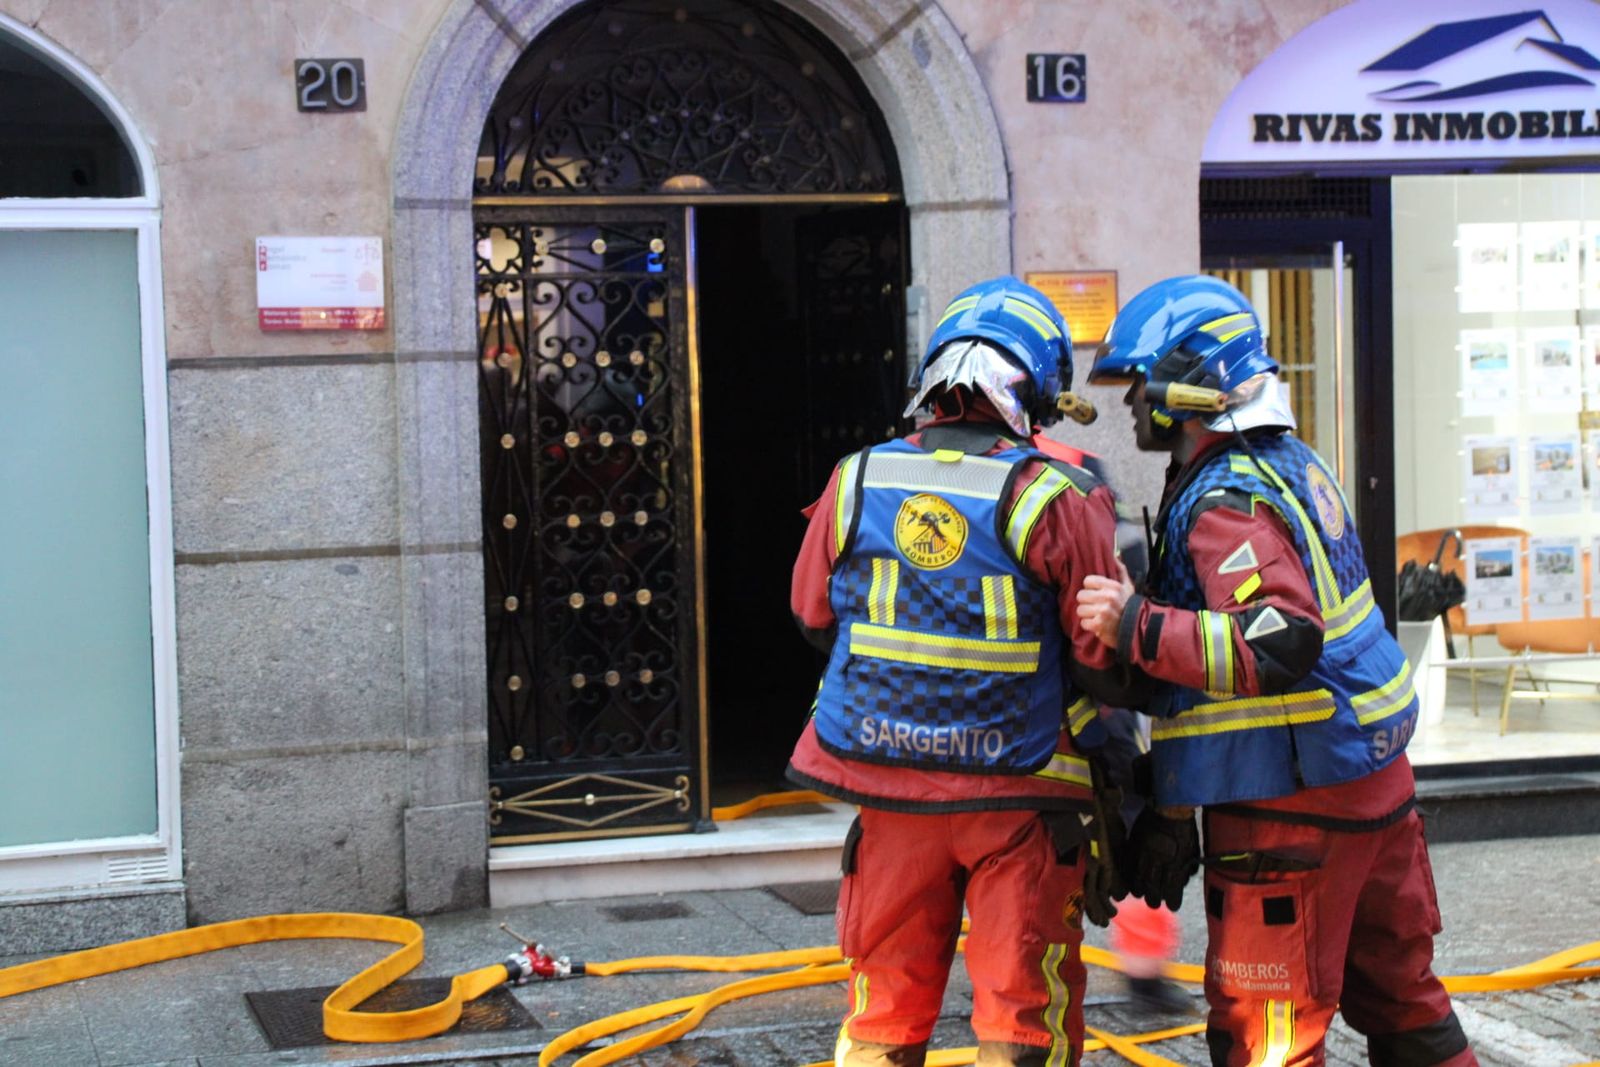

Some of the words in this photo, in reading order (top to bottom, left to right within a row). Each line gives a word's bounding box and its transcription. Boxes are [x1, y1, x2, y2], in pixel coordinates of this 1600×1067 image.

[299, 61, 357, 106] 20
[1034, 55, 1080, 98] 16
[1253, 113, 1382, 142] RIVAS
[904, 544, 957, 564] BOMBEROS
[860, 716, 1004, 758] SARGENTO
